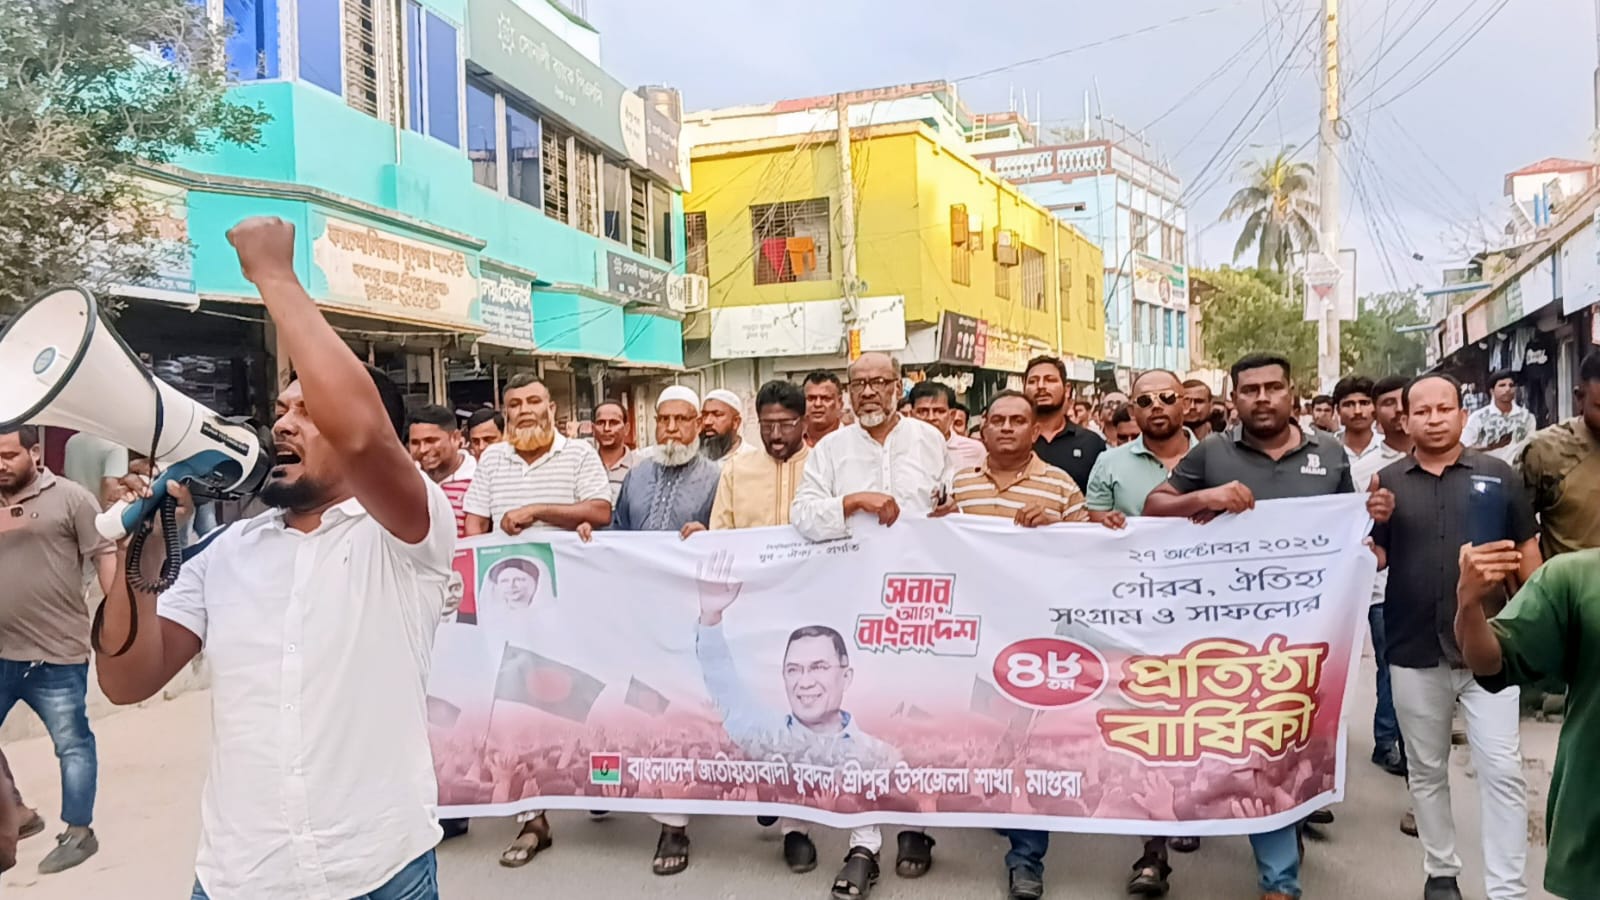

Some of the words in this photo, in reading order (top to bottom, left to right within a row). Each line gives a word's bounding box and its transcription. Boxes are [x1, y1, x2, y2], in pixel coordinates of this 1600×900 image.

[1129, 549, 1157, 562] ২৭
[1163, 540, 1250, 561] অক্টোবর
[1112, 572, 1216, 600] গৌরব,
[1228, 565, 1327, 593] ঐতিহ্য
[1049, 606, 1143, 628] সংগ্রাম
[1151, 608, 1176, 625] ও
[1186, 593, 1322, 623] সাফল্যের
[857, 614, 978, 648] বাংলাদেশ
[1006, 650, 1083, 688] ৪৮
[1126, 636, 1326, 701] প্রতিষ্ঠা
[1102, 691, 1316, 758] বার্ষিকী
[627, 755, 695, 784] বাংলাদেশ
[698, 750, 790, 786] জাতীয়তাবাদী
[792, 757, 840, 796] যুবদল,
[842, 760, 890, 801] শ্রীপুর
[895, 761, 968, 794] উপজেলা
[974, 767, 1021, 798] শাখা,
[1025, 768, 1083, 798] মাগুরা
